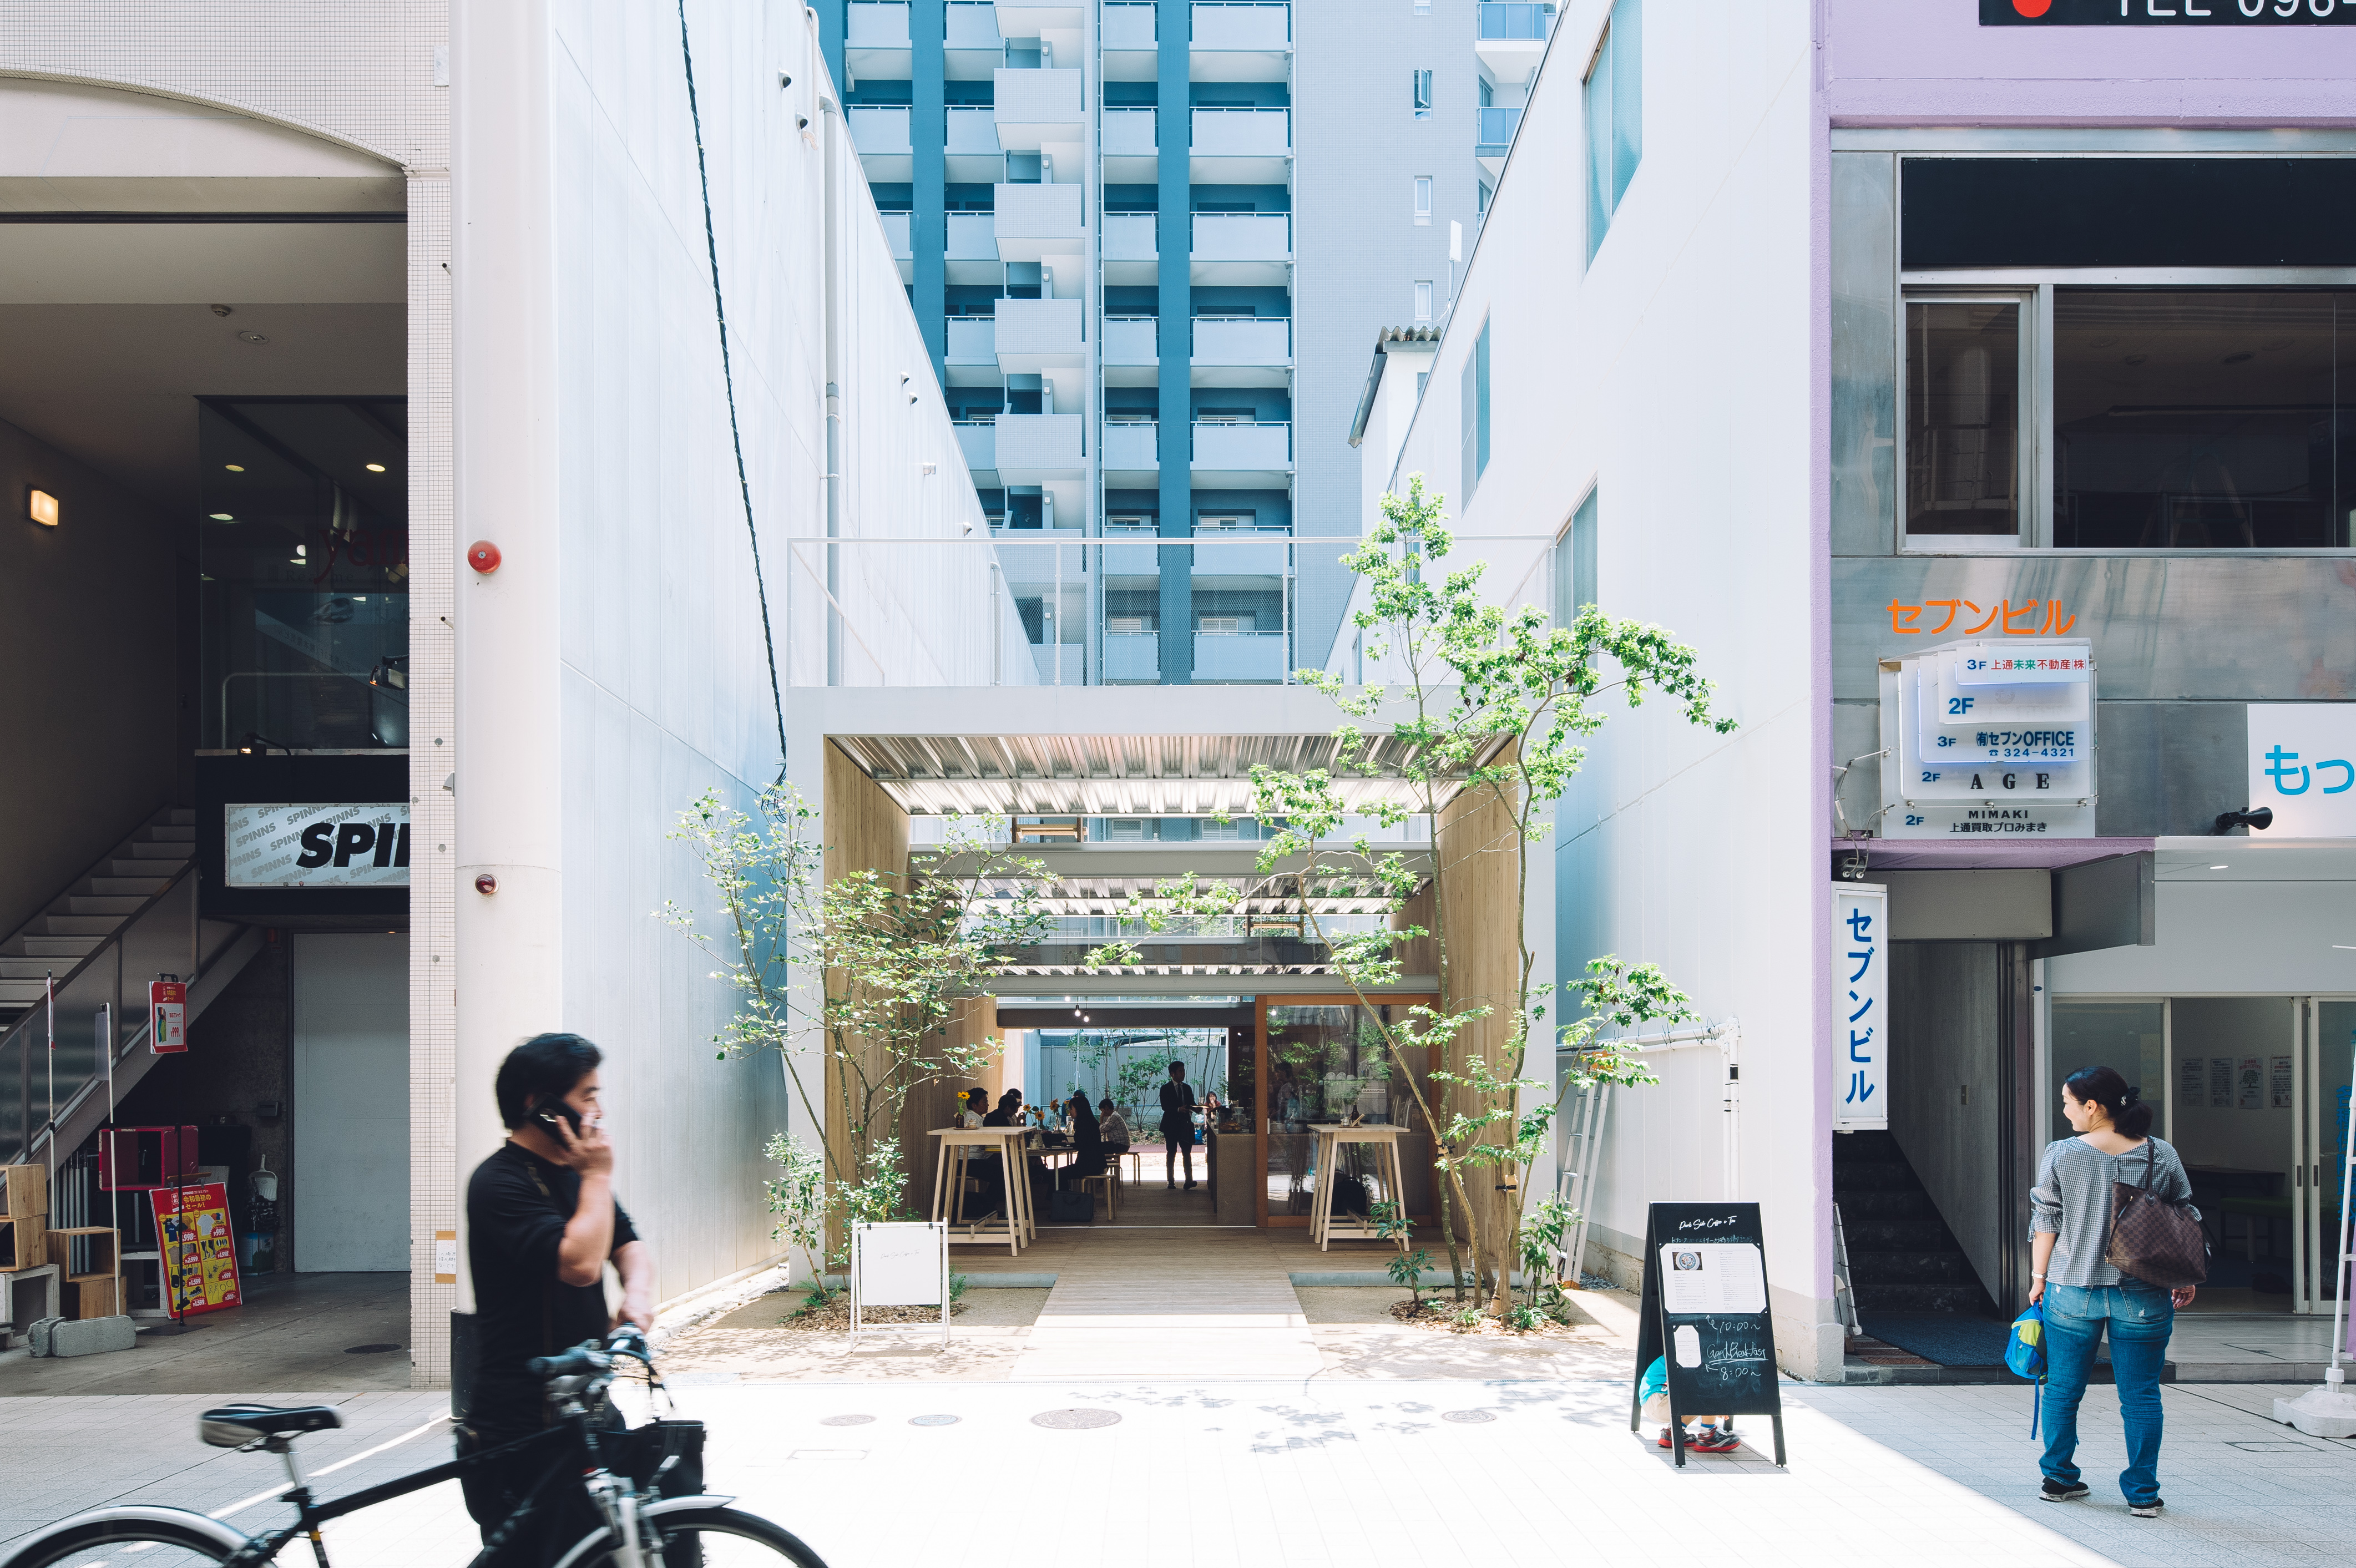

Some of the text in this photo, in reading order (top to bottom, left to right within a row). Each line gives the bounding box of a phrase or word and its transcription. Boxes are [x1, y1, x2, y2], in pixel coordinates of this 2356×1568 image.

[1887, 599, 2076, 635] セブンビル
[1967, 659, 1986, 670] 3F
[1949, 698, 1974, 714] 2F
[1937, 736, 1956, 747] 3F
[2004, 748, 2074, 757] 324-4321
[1922, 771, 1941, 782] 2F
[1905, 810, 2028, 826] 2F MIMAKI
[235, 822, 276, 848] SPINNS
[1949, 822, 2047, 833] 上通買取プロみまき
[295, 822, 410, 868] SPI
[251, 854, 292, 878] SPINNS
[1845, 908, 1875, 1104] セブンビル
[183, 1194, 211, 1203] 令和最初の
